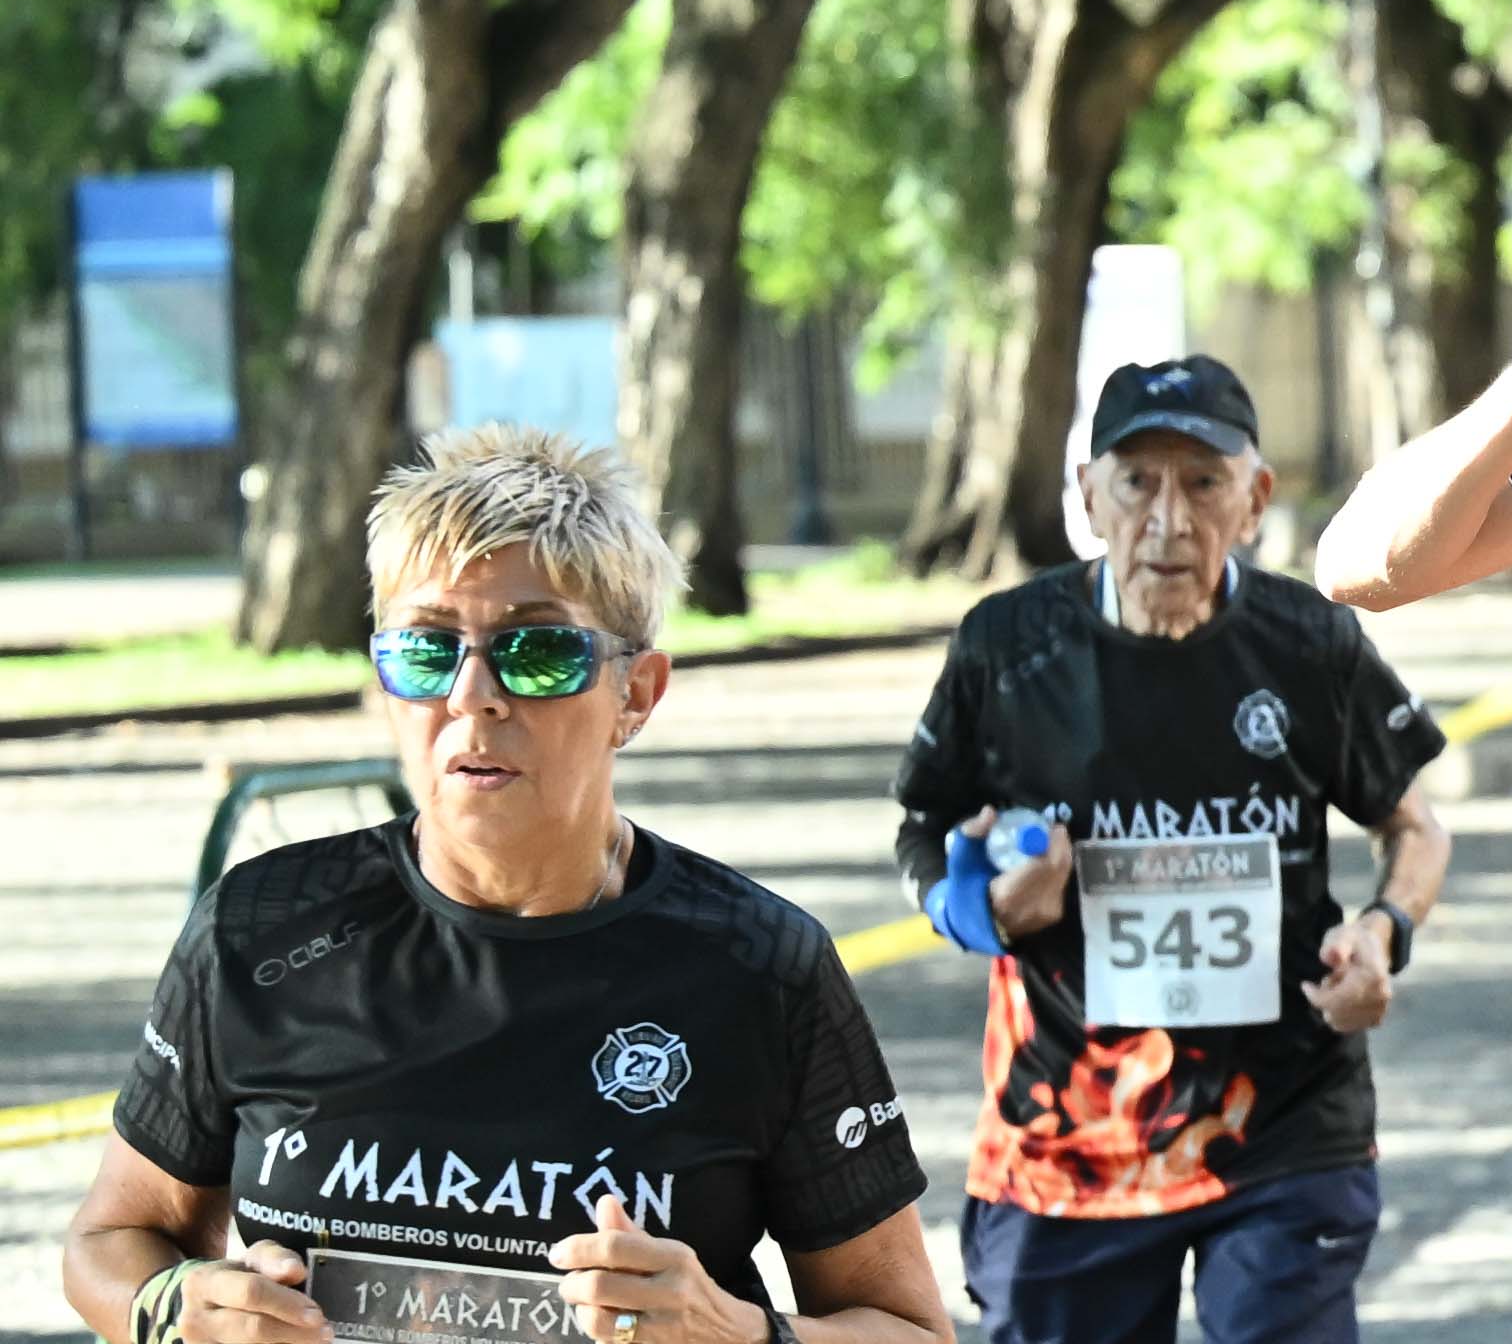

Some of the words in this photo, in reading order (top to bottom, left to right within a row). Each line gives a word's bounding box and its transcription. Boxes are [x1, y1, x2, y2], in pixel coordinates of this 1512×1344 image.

[1091, 782, 1299, 840] MARATÓN
[1129, 846, 1250, 880] MARATÓN
[1107, 906, 1254, 970] 543
[319, 1138, 675, 1231] MARATÓN
[331, 1220, 448, 1248] BOMBEROS
[453, 1232, 557, 1257] VOLUNTA
[396, 1287, 588, 1337] MARATÓN
